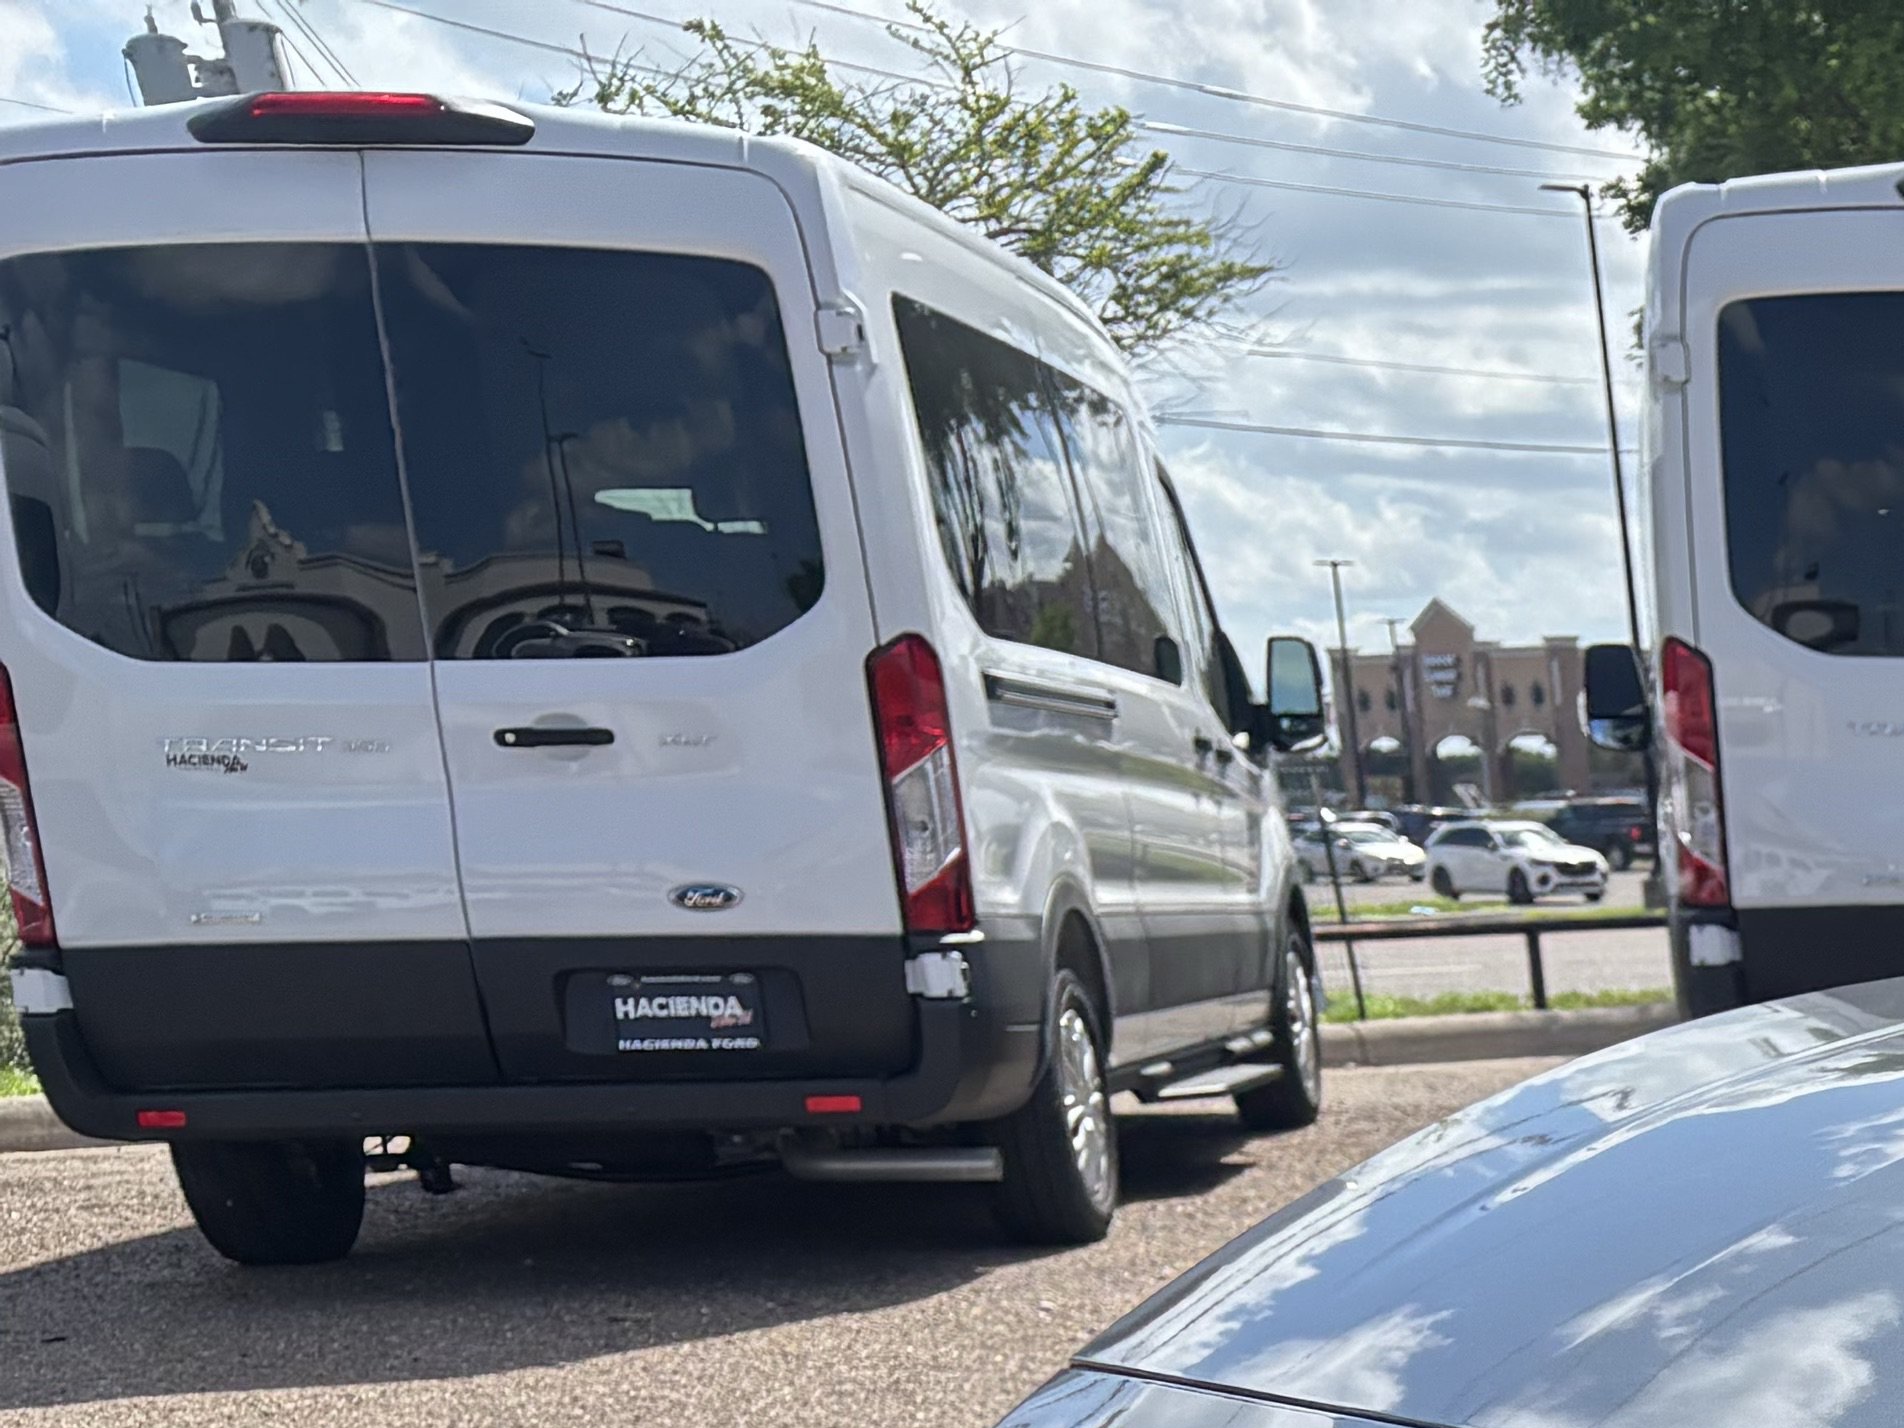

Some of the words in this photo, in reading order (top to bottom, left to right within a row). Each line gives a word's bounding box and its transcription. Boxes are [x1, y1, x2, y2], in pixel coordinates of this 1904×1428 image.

[157, 736, 333, 752] TRANSIT
[166, 754, 241, 768] HACIENDA
[614, 996, 743, 1020] HACIENDA
[618, 1037, 708, 1050] HACIENDA
